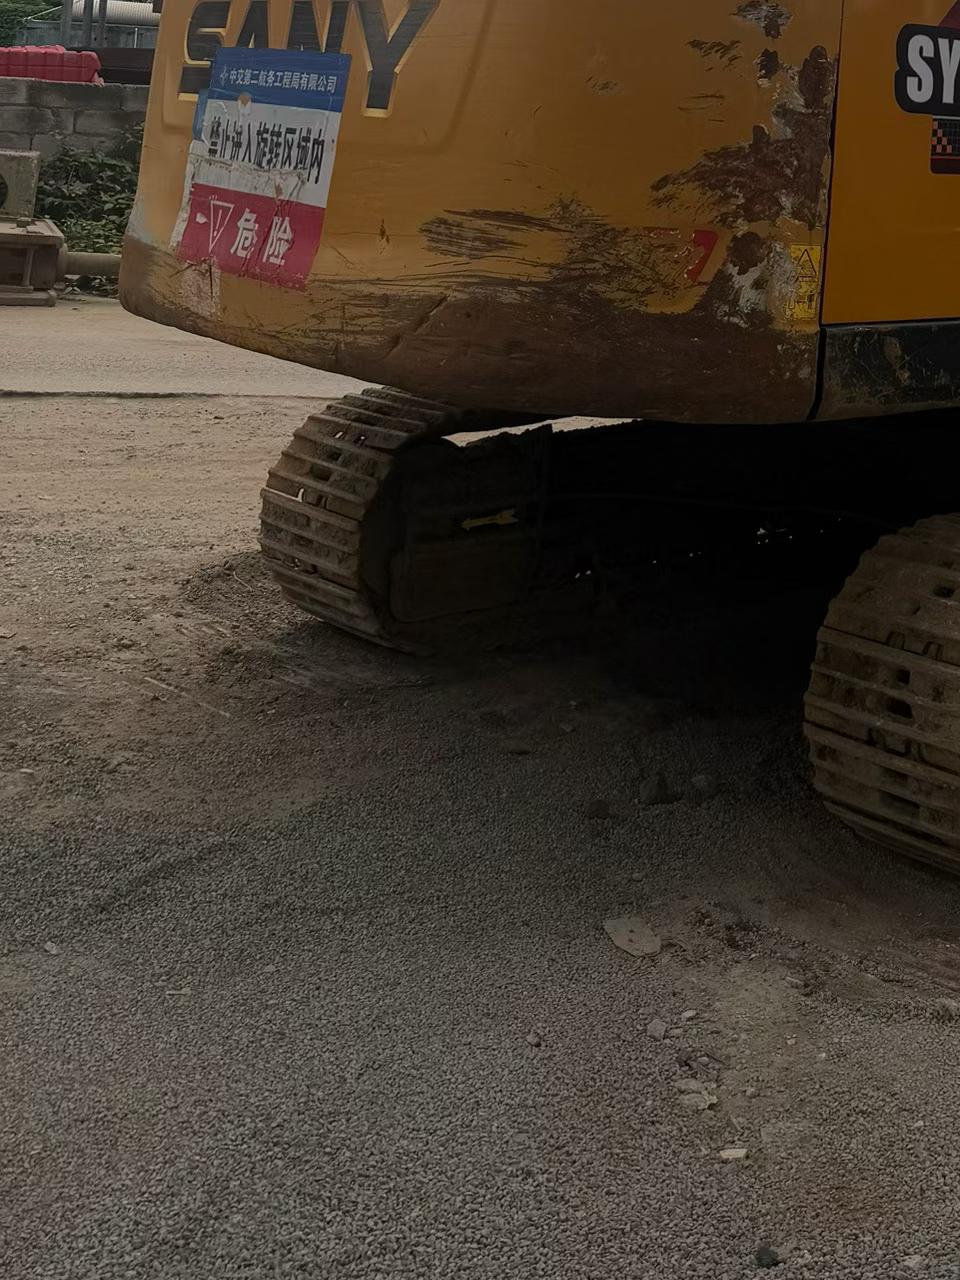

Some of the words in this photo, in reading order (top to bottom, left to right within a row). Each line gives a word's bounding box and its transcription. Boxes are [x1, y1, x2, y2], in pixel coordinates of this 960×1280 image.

[229, 67, 338, 95] 中交第二航务工程局有限公司
[230, 207, 295, 266] 危险
